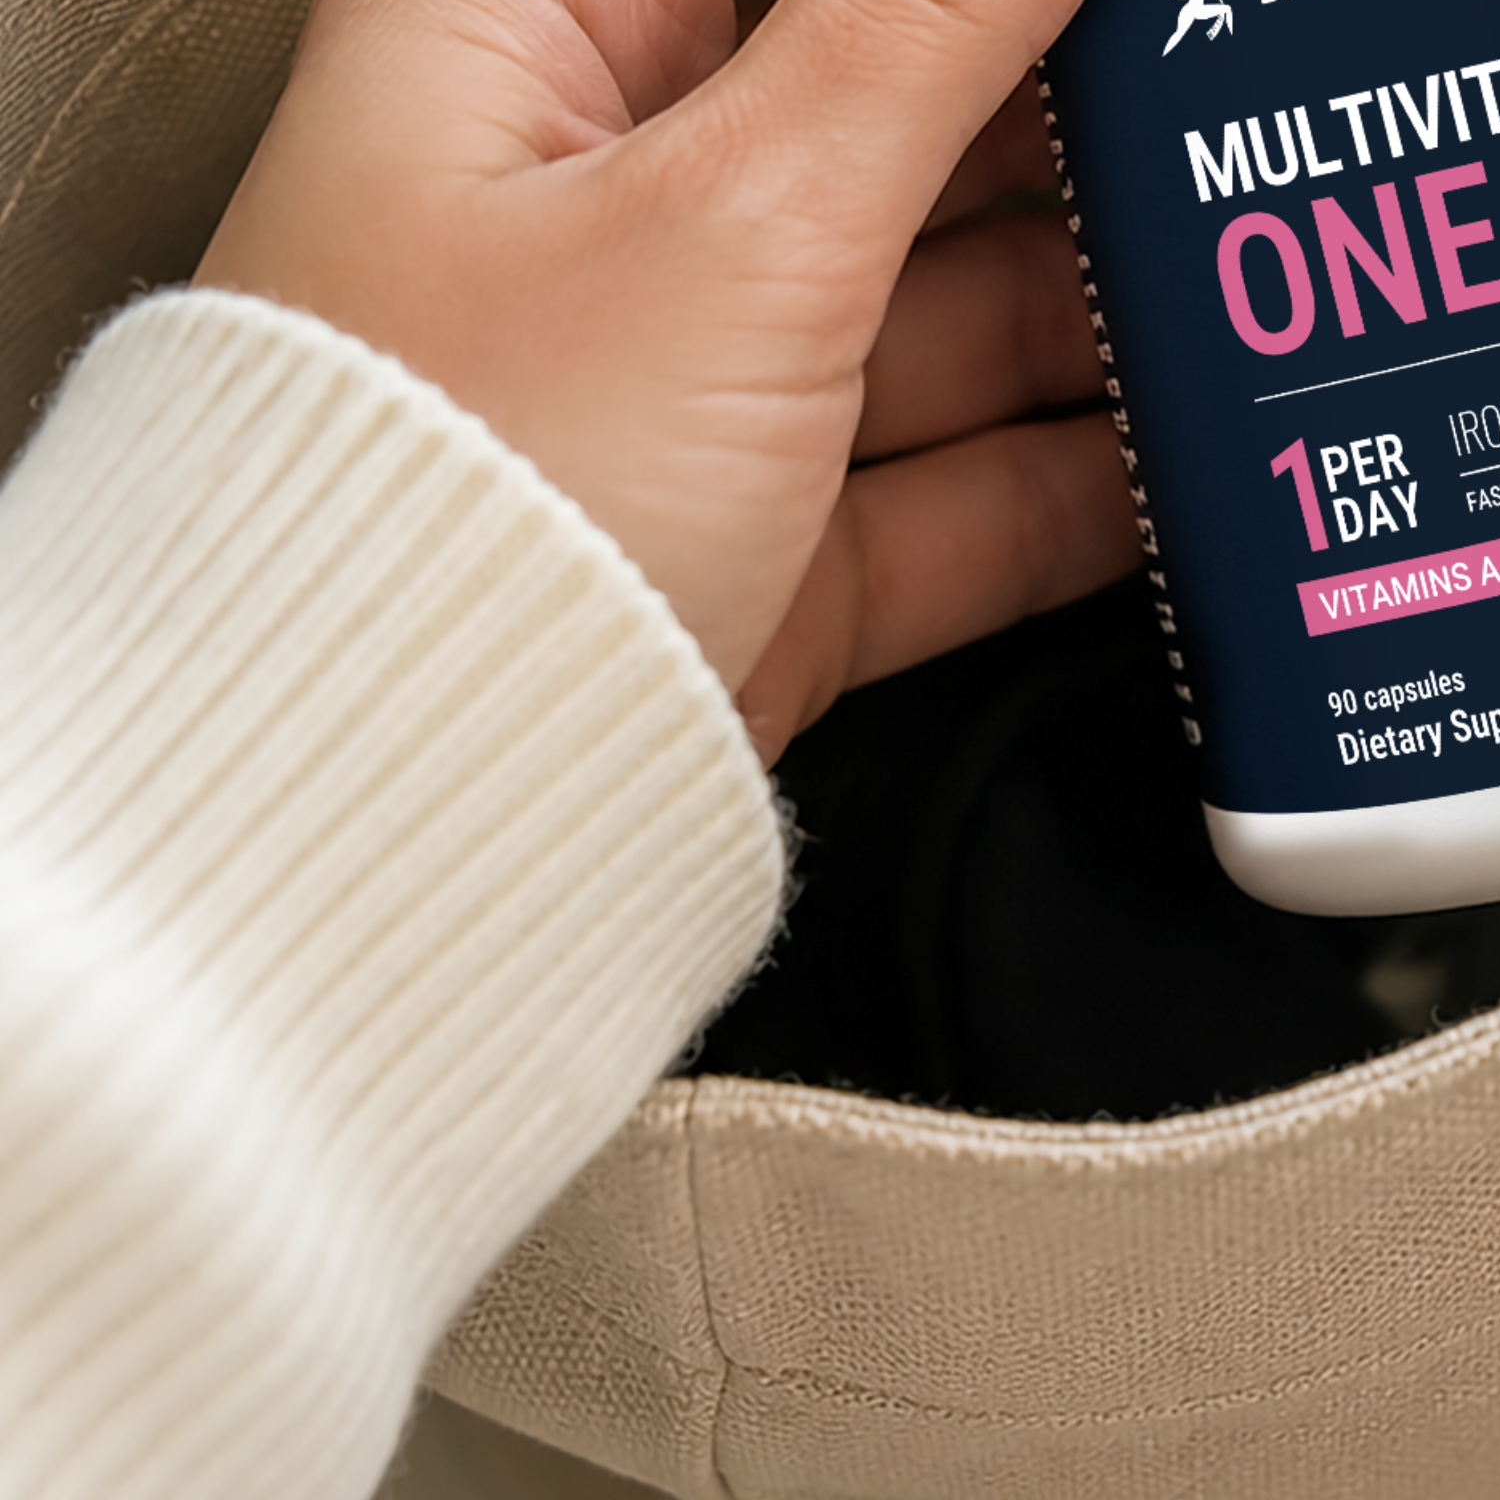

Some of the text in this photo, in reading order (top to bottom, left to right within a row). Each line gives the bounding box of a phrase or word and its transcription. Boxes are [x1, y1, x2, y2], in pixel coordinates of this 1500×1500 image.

[1270, 433, 1411, 552] 1 PER
[1332, 480, 1418, 543] DAY
[1318, 562, 1472, 620] VITAMINS
[1327, 669, 1466, 718] 90 capsules
[1336, 721, 1442, 766] Dietary
